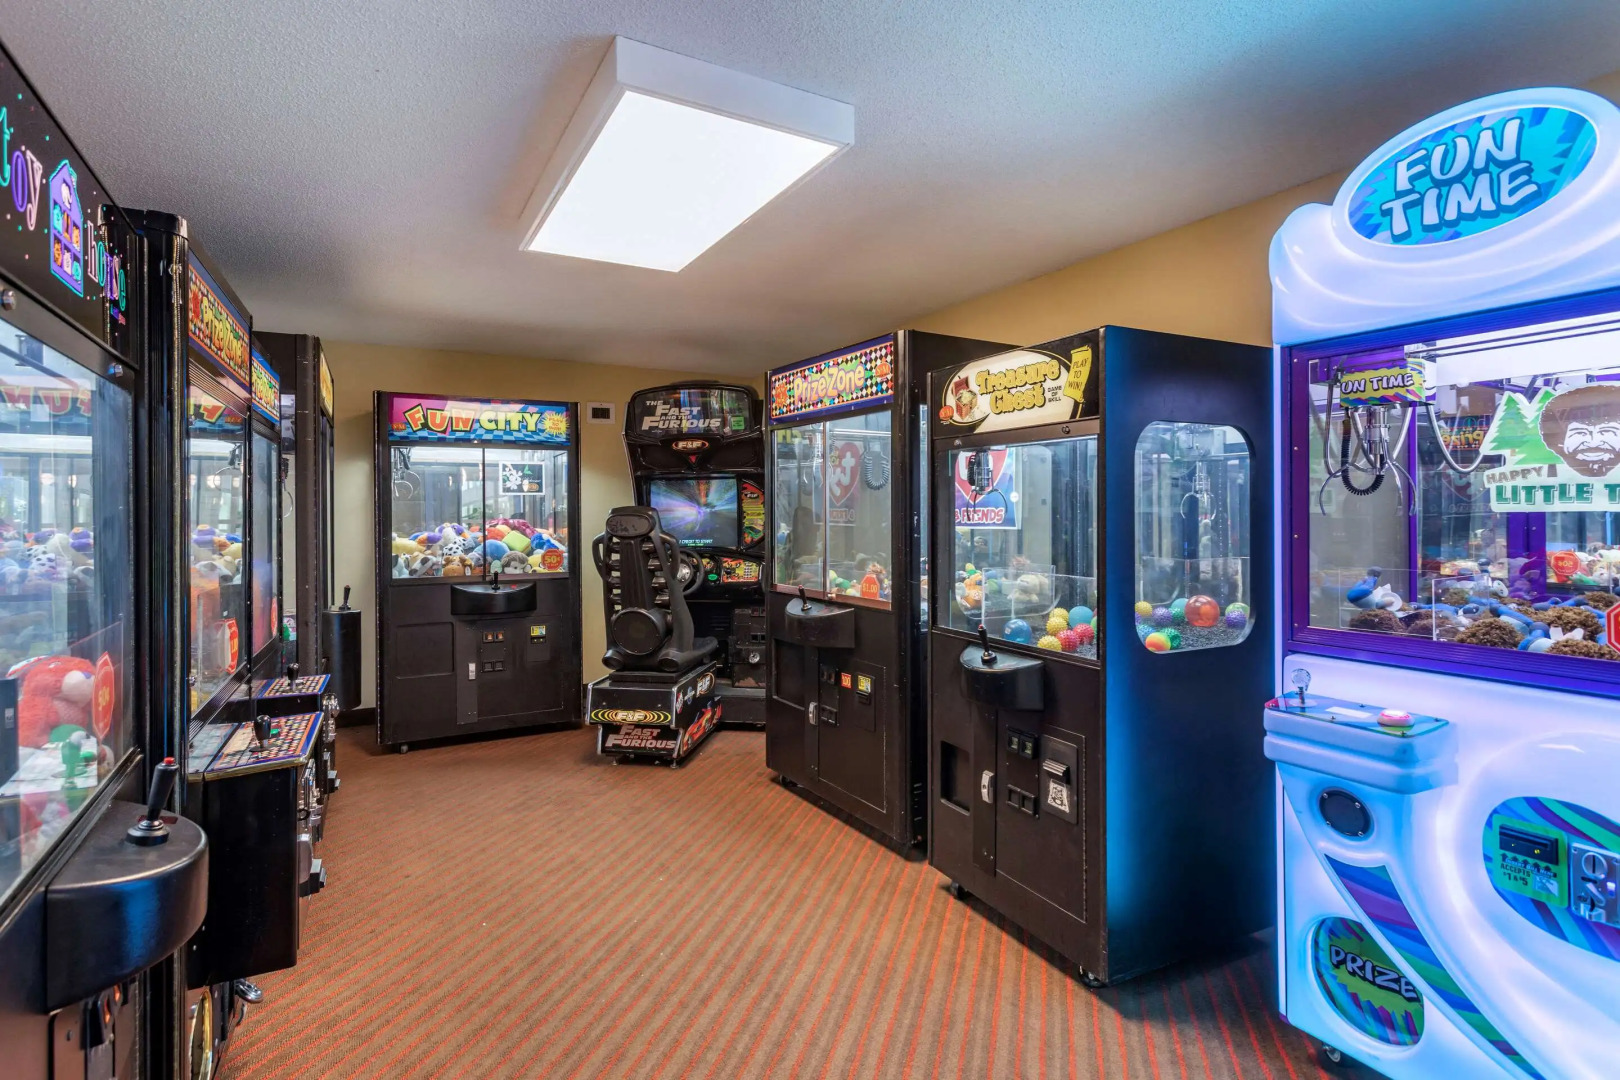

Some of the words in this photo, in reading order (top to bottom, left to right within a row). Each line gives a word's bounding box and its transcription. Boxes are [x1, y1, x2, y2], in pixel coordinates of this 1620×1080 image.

[1395, 117, 1524, 195] FUN
[1380, 162, 1542, 242] TIME
[1072, 358, 1088, 369] PLAY
[975, 359, 1060, 395] Treasure
[1073, 370, 1081, 379] TO
[1068, 380, 1082, 391] WIN!
[1370, 373, 1415, 392] TIME
[989, 383, 1045, 415] Chest
[655, 404, 700, 417] FAST
[403, 403, 475, 434] FUN
[478, 410, 542, 433] CITY
[641, 416, 721, 430] FURIOUS
[678, 441, 702, 449] F&F
[1486, 466, 1544, 484] HAPPY
[1495, 483, 1594, 505] LITTLE
[862, 582, 878, 593] $1.00
[616, 711, 646, 721] F&F
[620, 723, 661, 737] FAST
[605, 734, 676, 749] FURIOUS
[1501, 863, 1531, 878] ACCEPTS
[1330, 944, 1420, 1002] PRIZE
